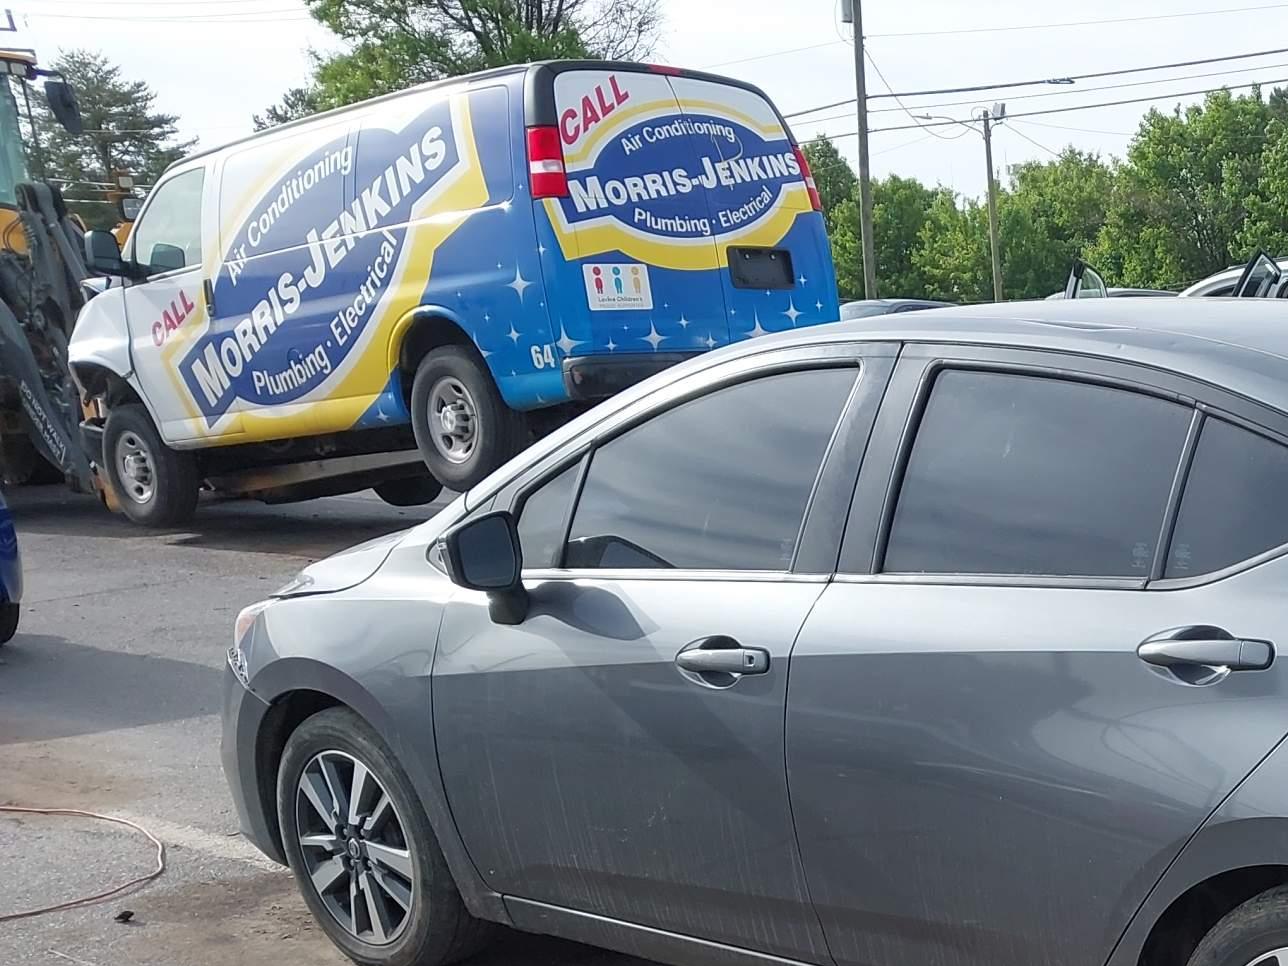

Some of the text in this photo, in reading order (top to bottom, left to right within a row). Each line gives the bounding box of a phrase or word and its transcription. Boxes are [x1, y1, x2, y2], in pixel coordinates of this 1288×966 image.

[560, 75, 630, 145] CALL
[620, 118, 735, 155] Air Conditioning
[567, 151, 801, 213] MORRIS-JENKINS
[634, 186, 774, 235] Plumbing Electrical
[226, 146, 353, 287] Air Conditioning
[190, 126, 447, 407] MORRIS-JENKINS
[151, 290, 195, 347] CALL
[252, 229, 397, 397] Plumbing Electrical
[530, 344, 556, 370] 64
